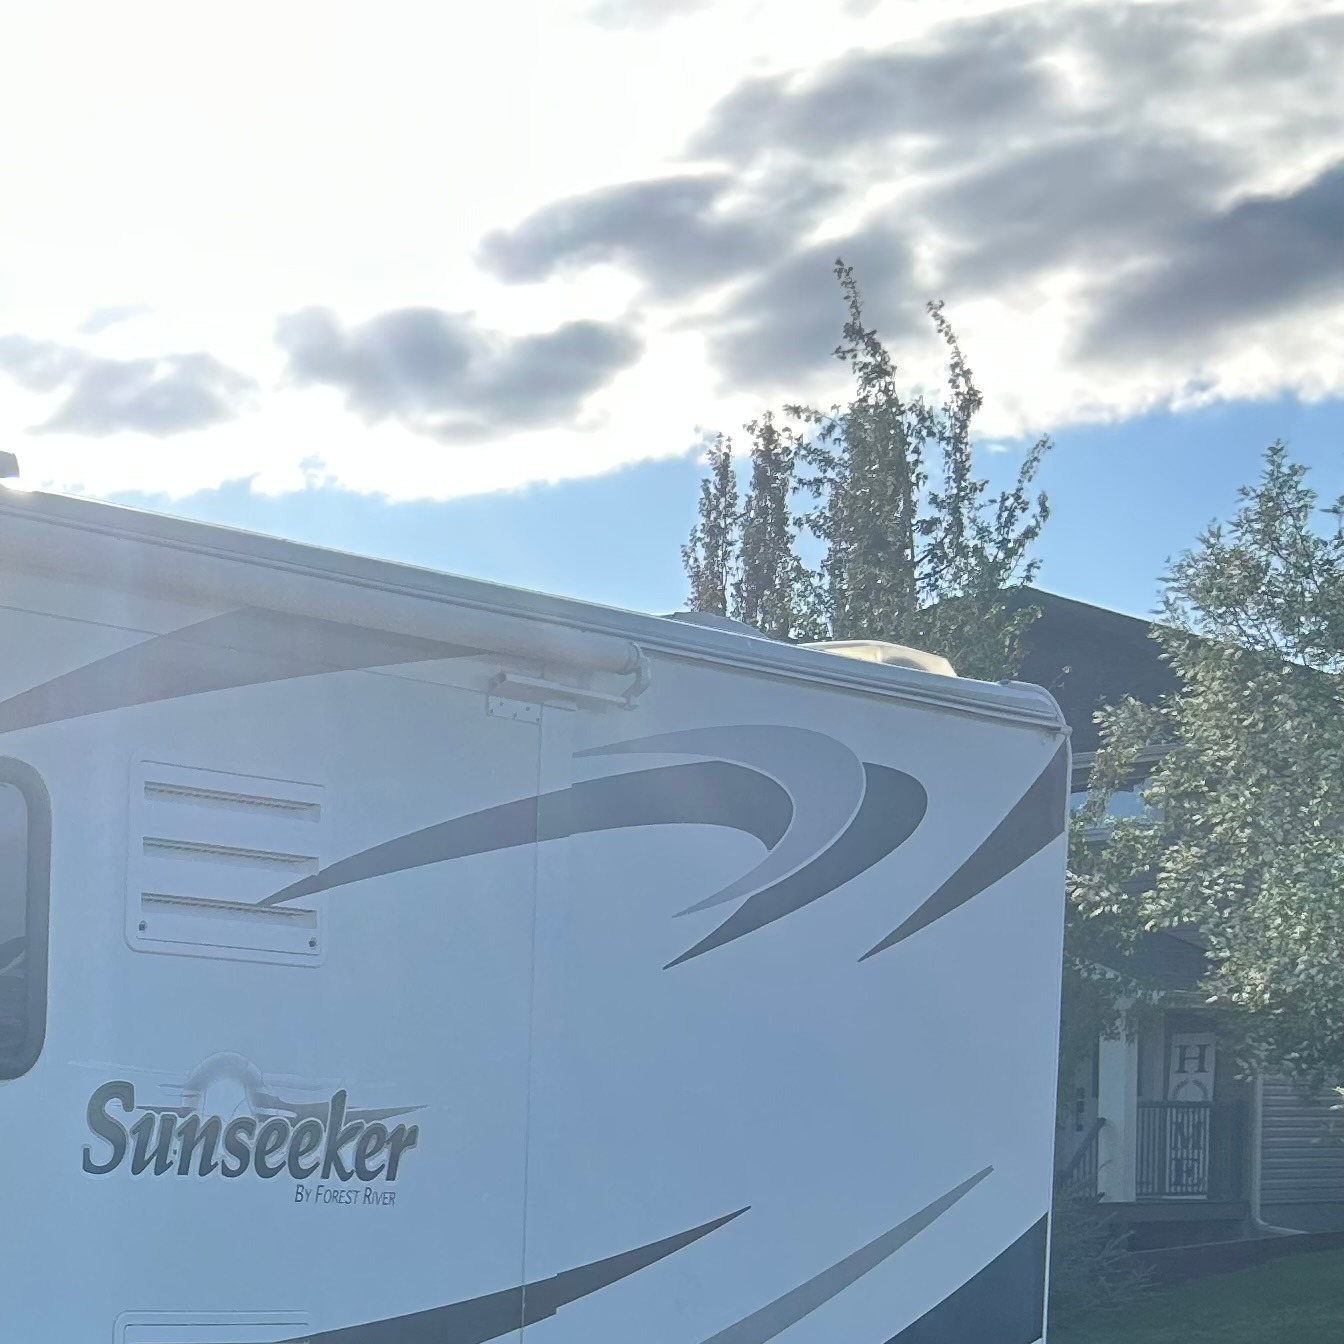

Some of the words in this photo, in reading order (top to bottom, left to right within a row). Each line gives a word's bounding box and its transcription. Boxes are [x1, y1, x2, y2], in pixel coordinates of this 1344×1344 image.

[81, 1079, 420, 1182] Sunseeker
[295, 1184, 313, 1203] BY
[315, 1184, 361, 1205] FOREST
[362, 1186, 397, 1207] RIVER
